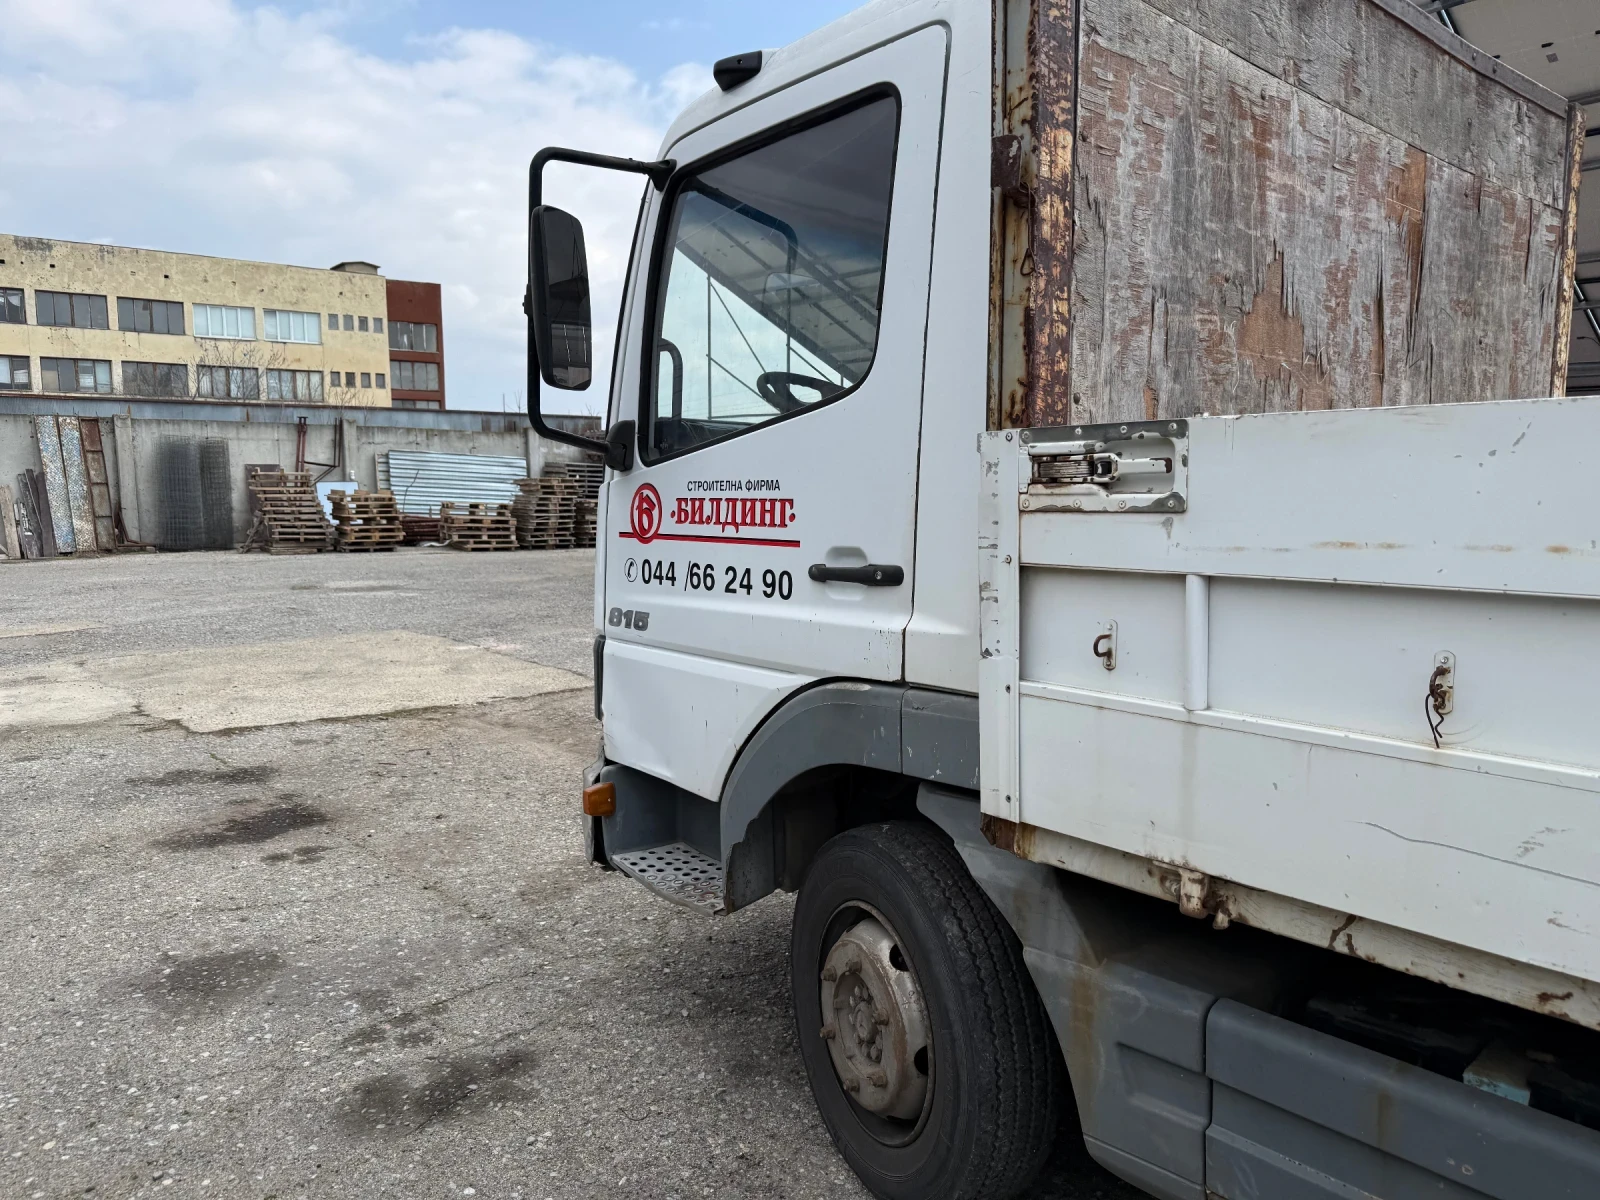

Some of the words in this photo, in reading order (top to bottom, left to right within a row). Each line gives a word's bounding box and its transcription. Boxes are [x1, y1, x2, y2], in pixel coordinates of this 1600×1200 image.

[687, 480, 743, 492] СТРОИТЕЛНА
[745, 479, 781, 493] ФИРМА
[641, 558, 676, 586] 044
[724, 565, 753, 596] 24
[762, 568, 793, 600] 90
[608, 607, 650, 632] 815
